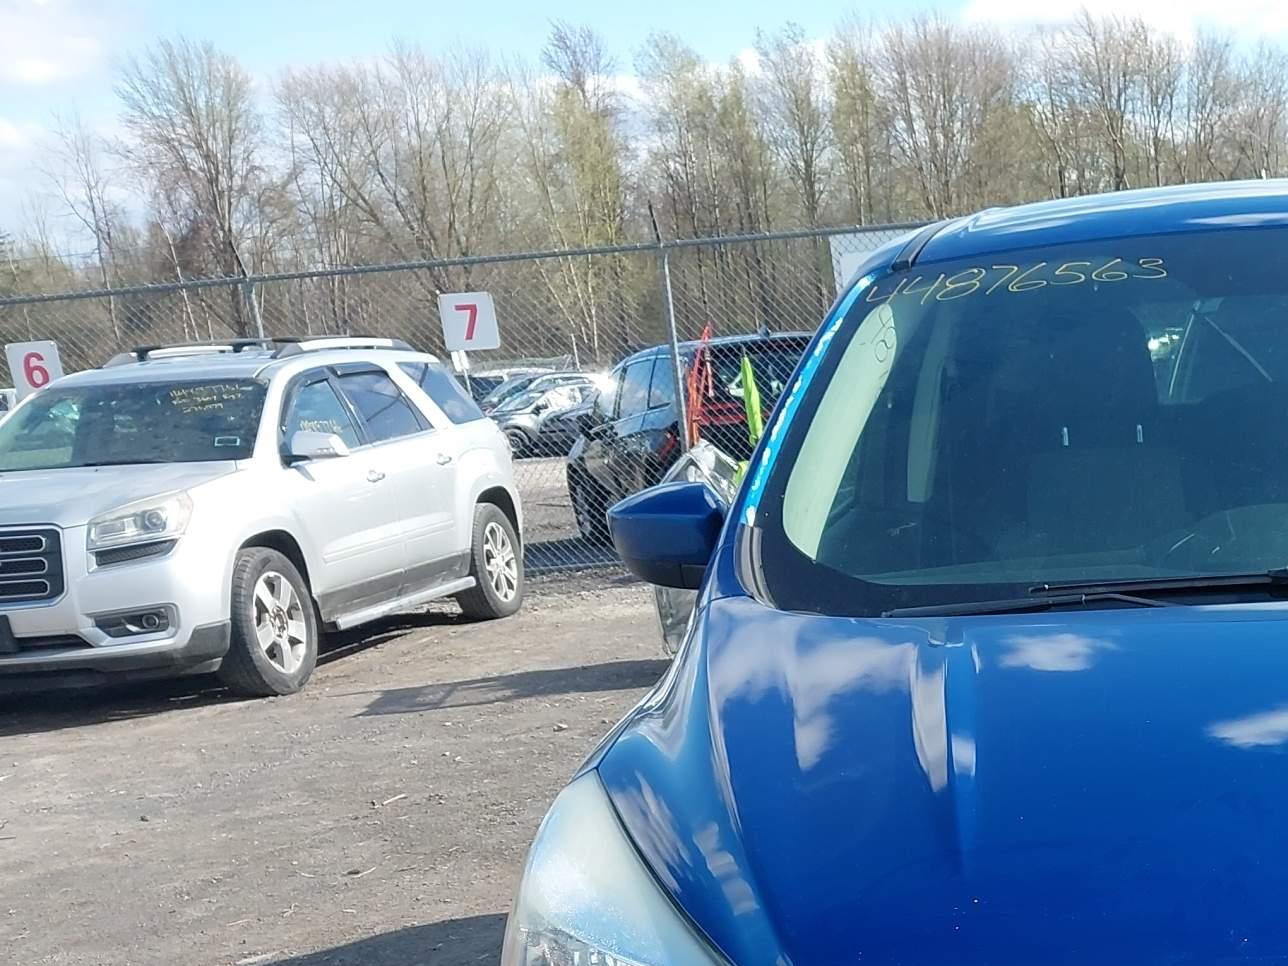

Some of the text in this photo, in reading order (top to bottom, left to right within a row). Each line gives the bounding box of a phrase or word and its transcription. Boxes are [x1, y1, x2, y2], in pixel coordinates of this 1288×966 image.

[865, 257, 1168, 305] 44876563
[453, 303, 479, 341] 7
[23, 351, 50, 389] 6
